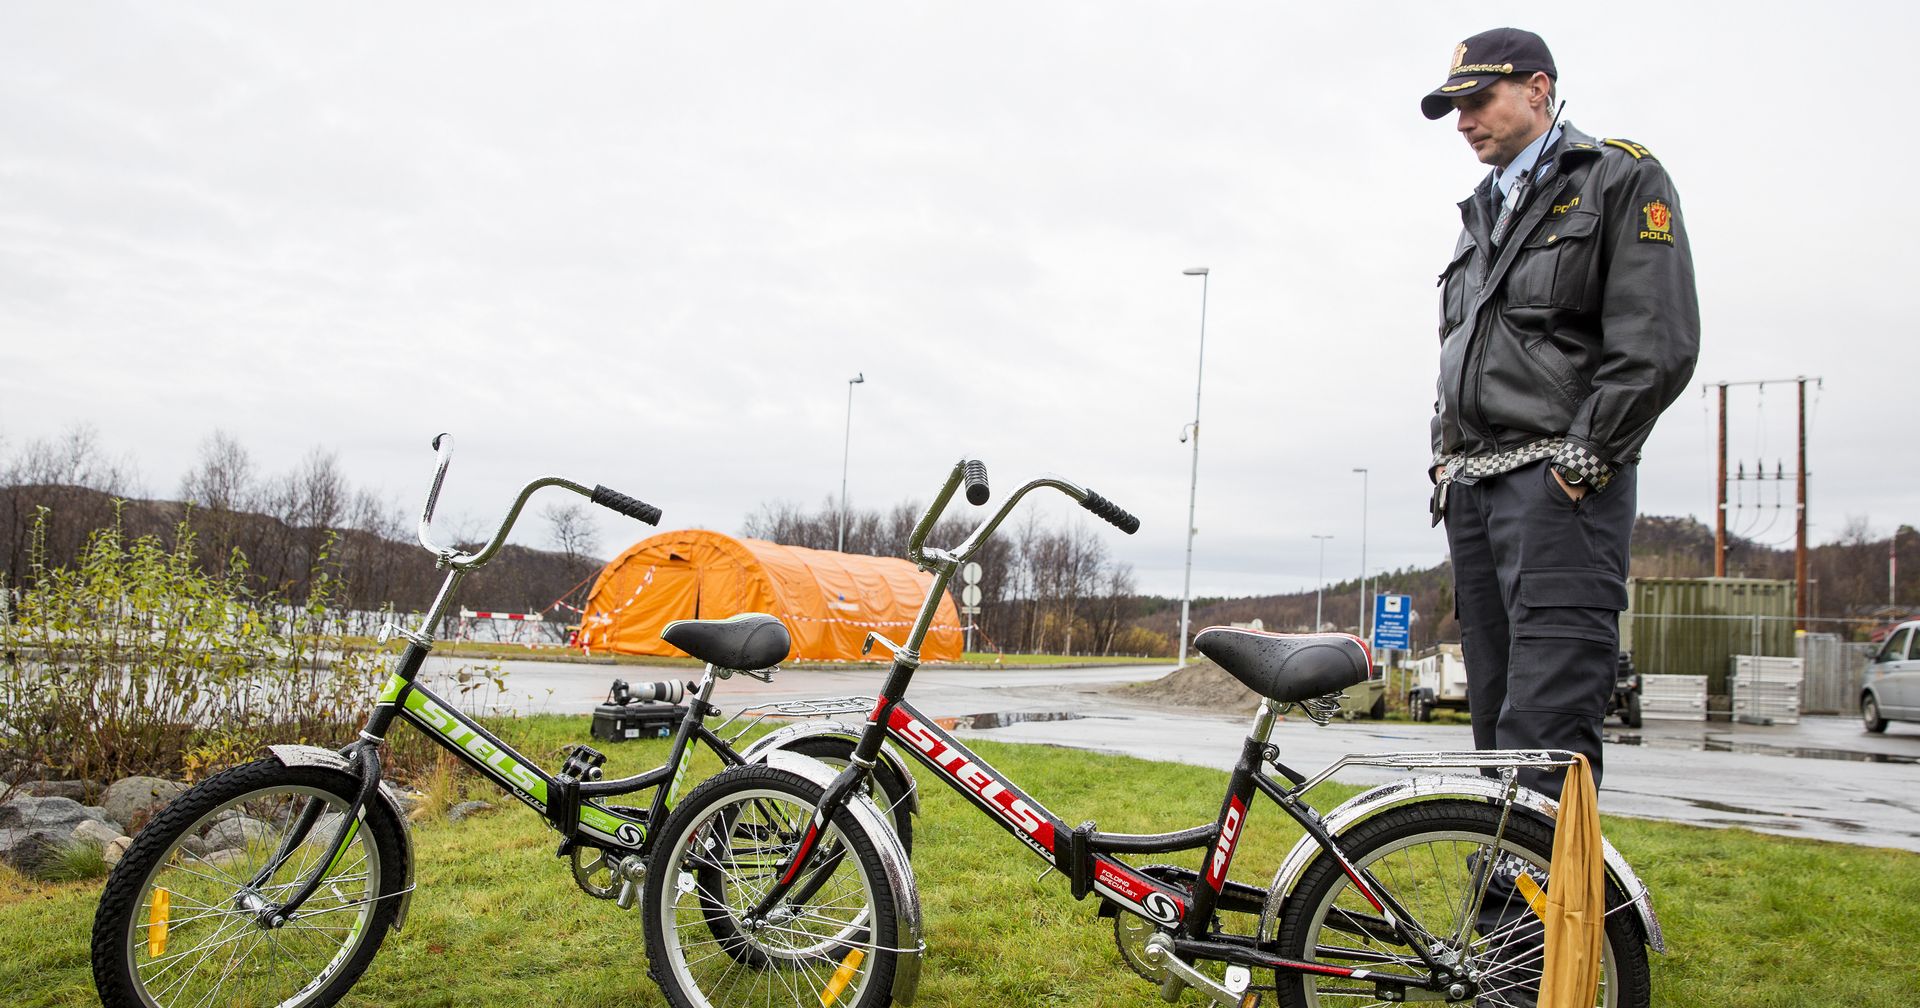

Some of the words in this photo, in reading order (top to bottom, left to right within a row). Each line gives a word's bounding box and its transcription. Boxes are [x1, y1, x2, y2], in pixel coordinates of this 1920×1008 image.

[1640, 231, 1674, 244] POLITI
[414, 700, 543, 791] STELS
[899, 719, 1049, 834] STELS
[1213, 806, 1240, 879] 410
[1099, 874, 1138, 898] SPECIALIST
[1101, 869, 1130, 888] FOLDING
